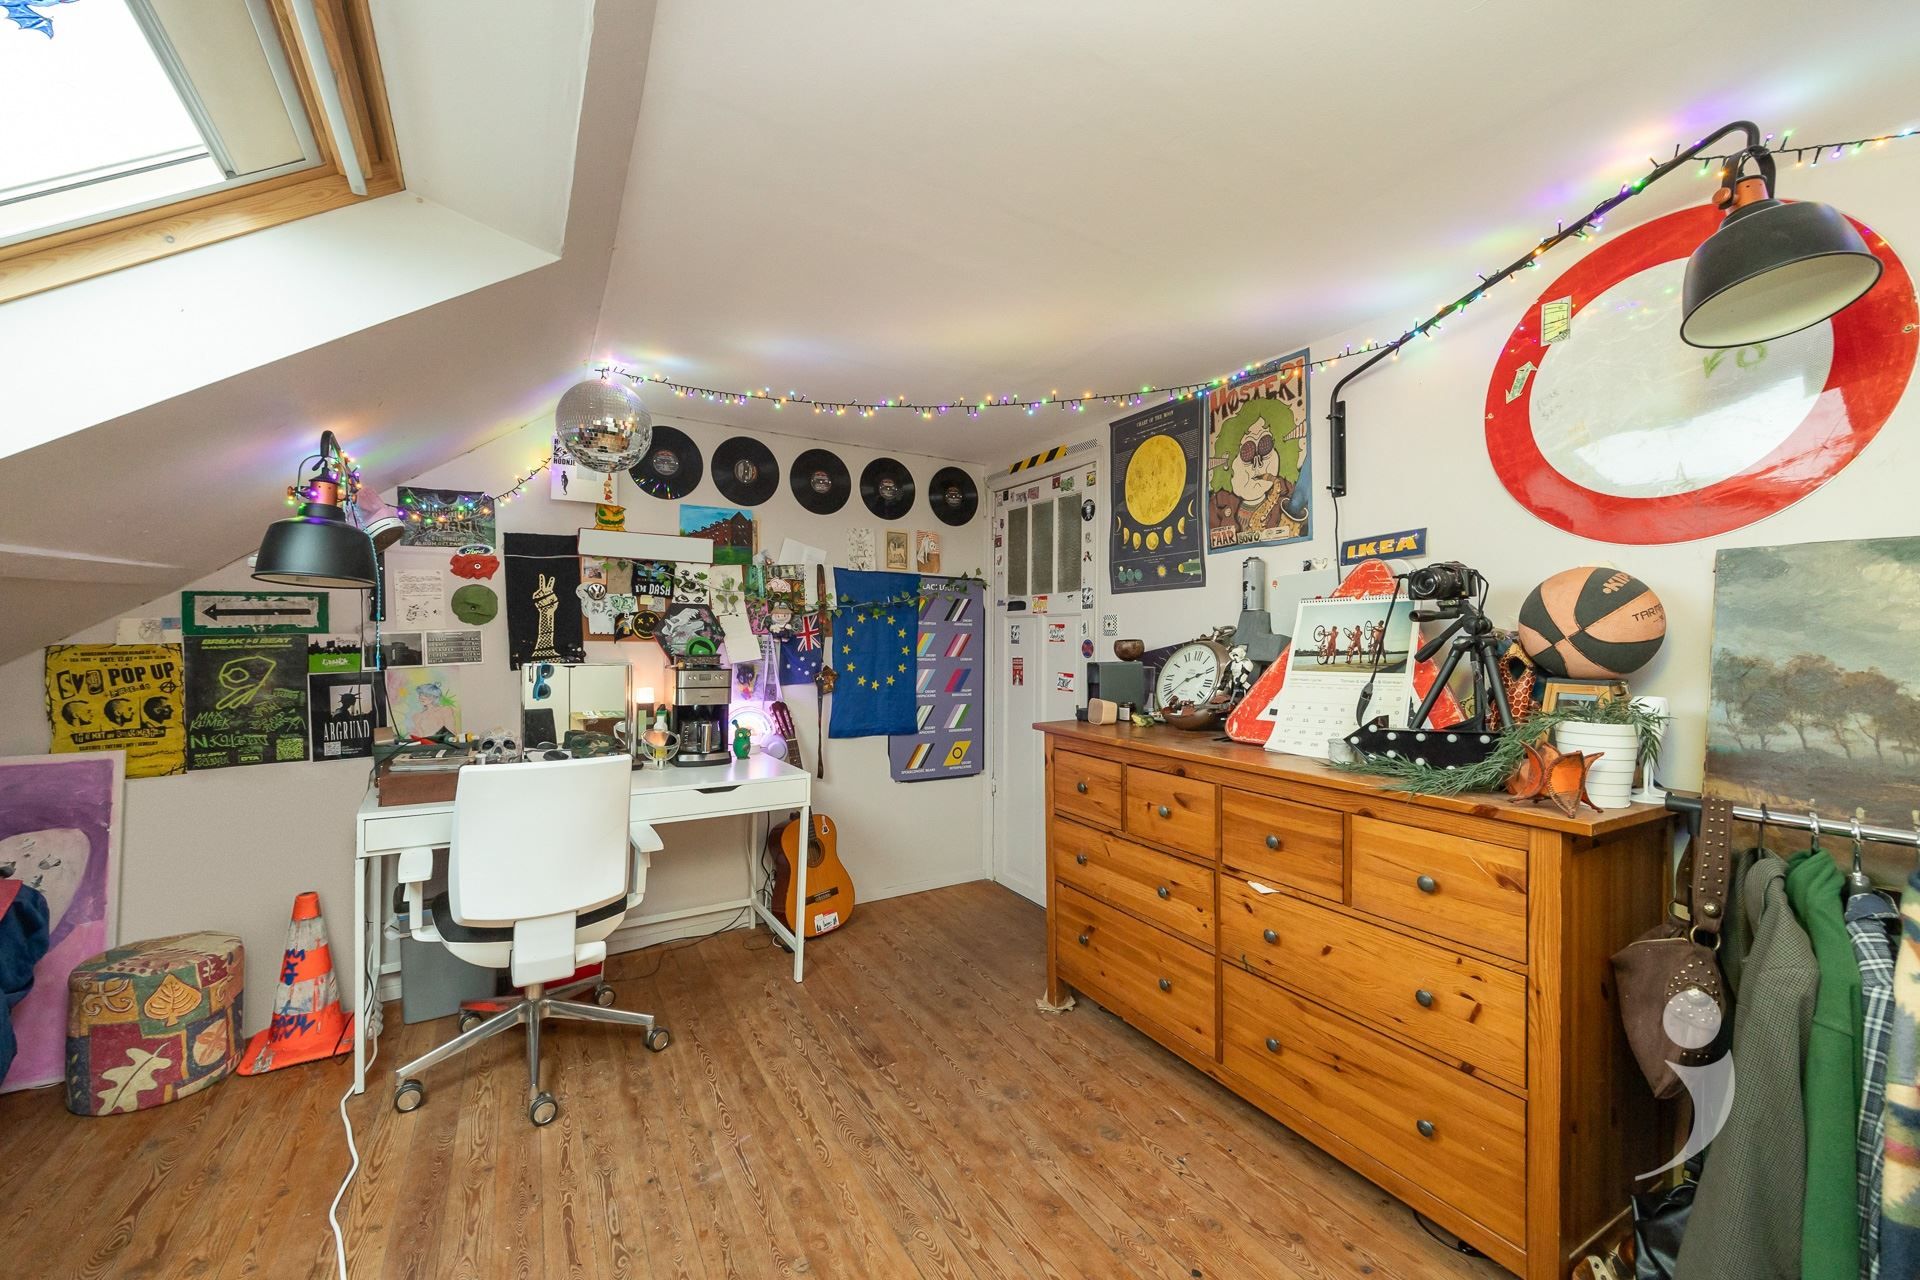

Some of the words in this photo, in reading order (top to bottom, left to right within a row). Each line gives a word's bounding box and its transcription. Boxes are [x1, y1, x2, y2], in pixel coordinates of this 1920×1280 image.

[464, 547, 485, 555] Ford
[1347, 534, 1418, 560] IKEA
[648, 582, 671, 596] DASH
[107, 666, 147, 687] POP
[149, 661, 175, 680] UP
